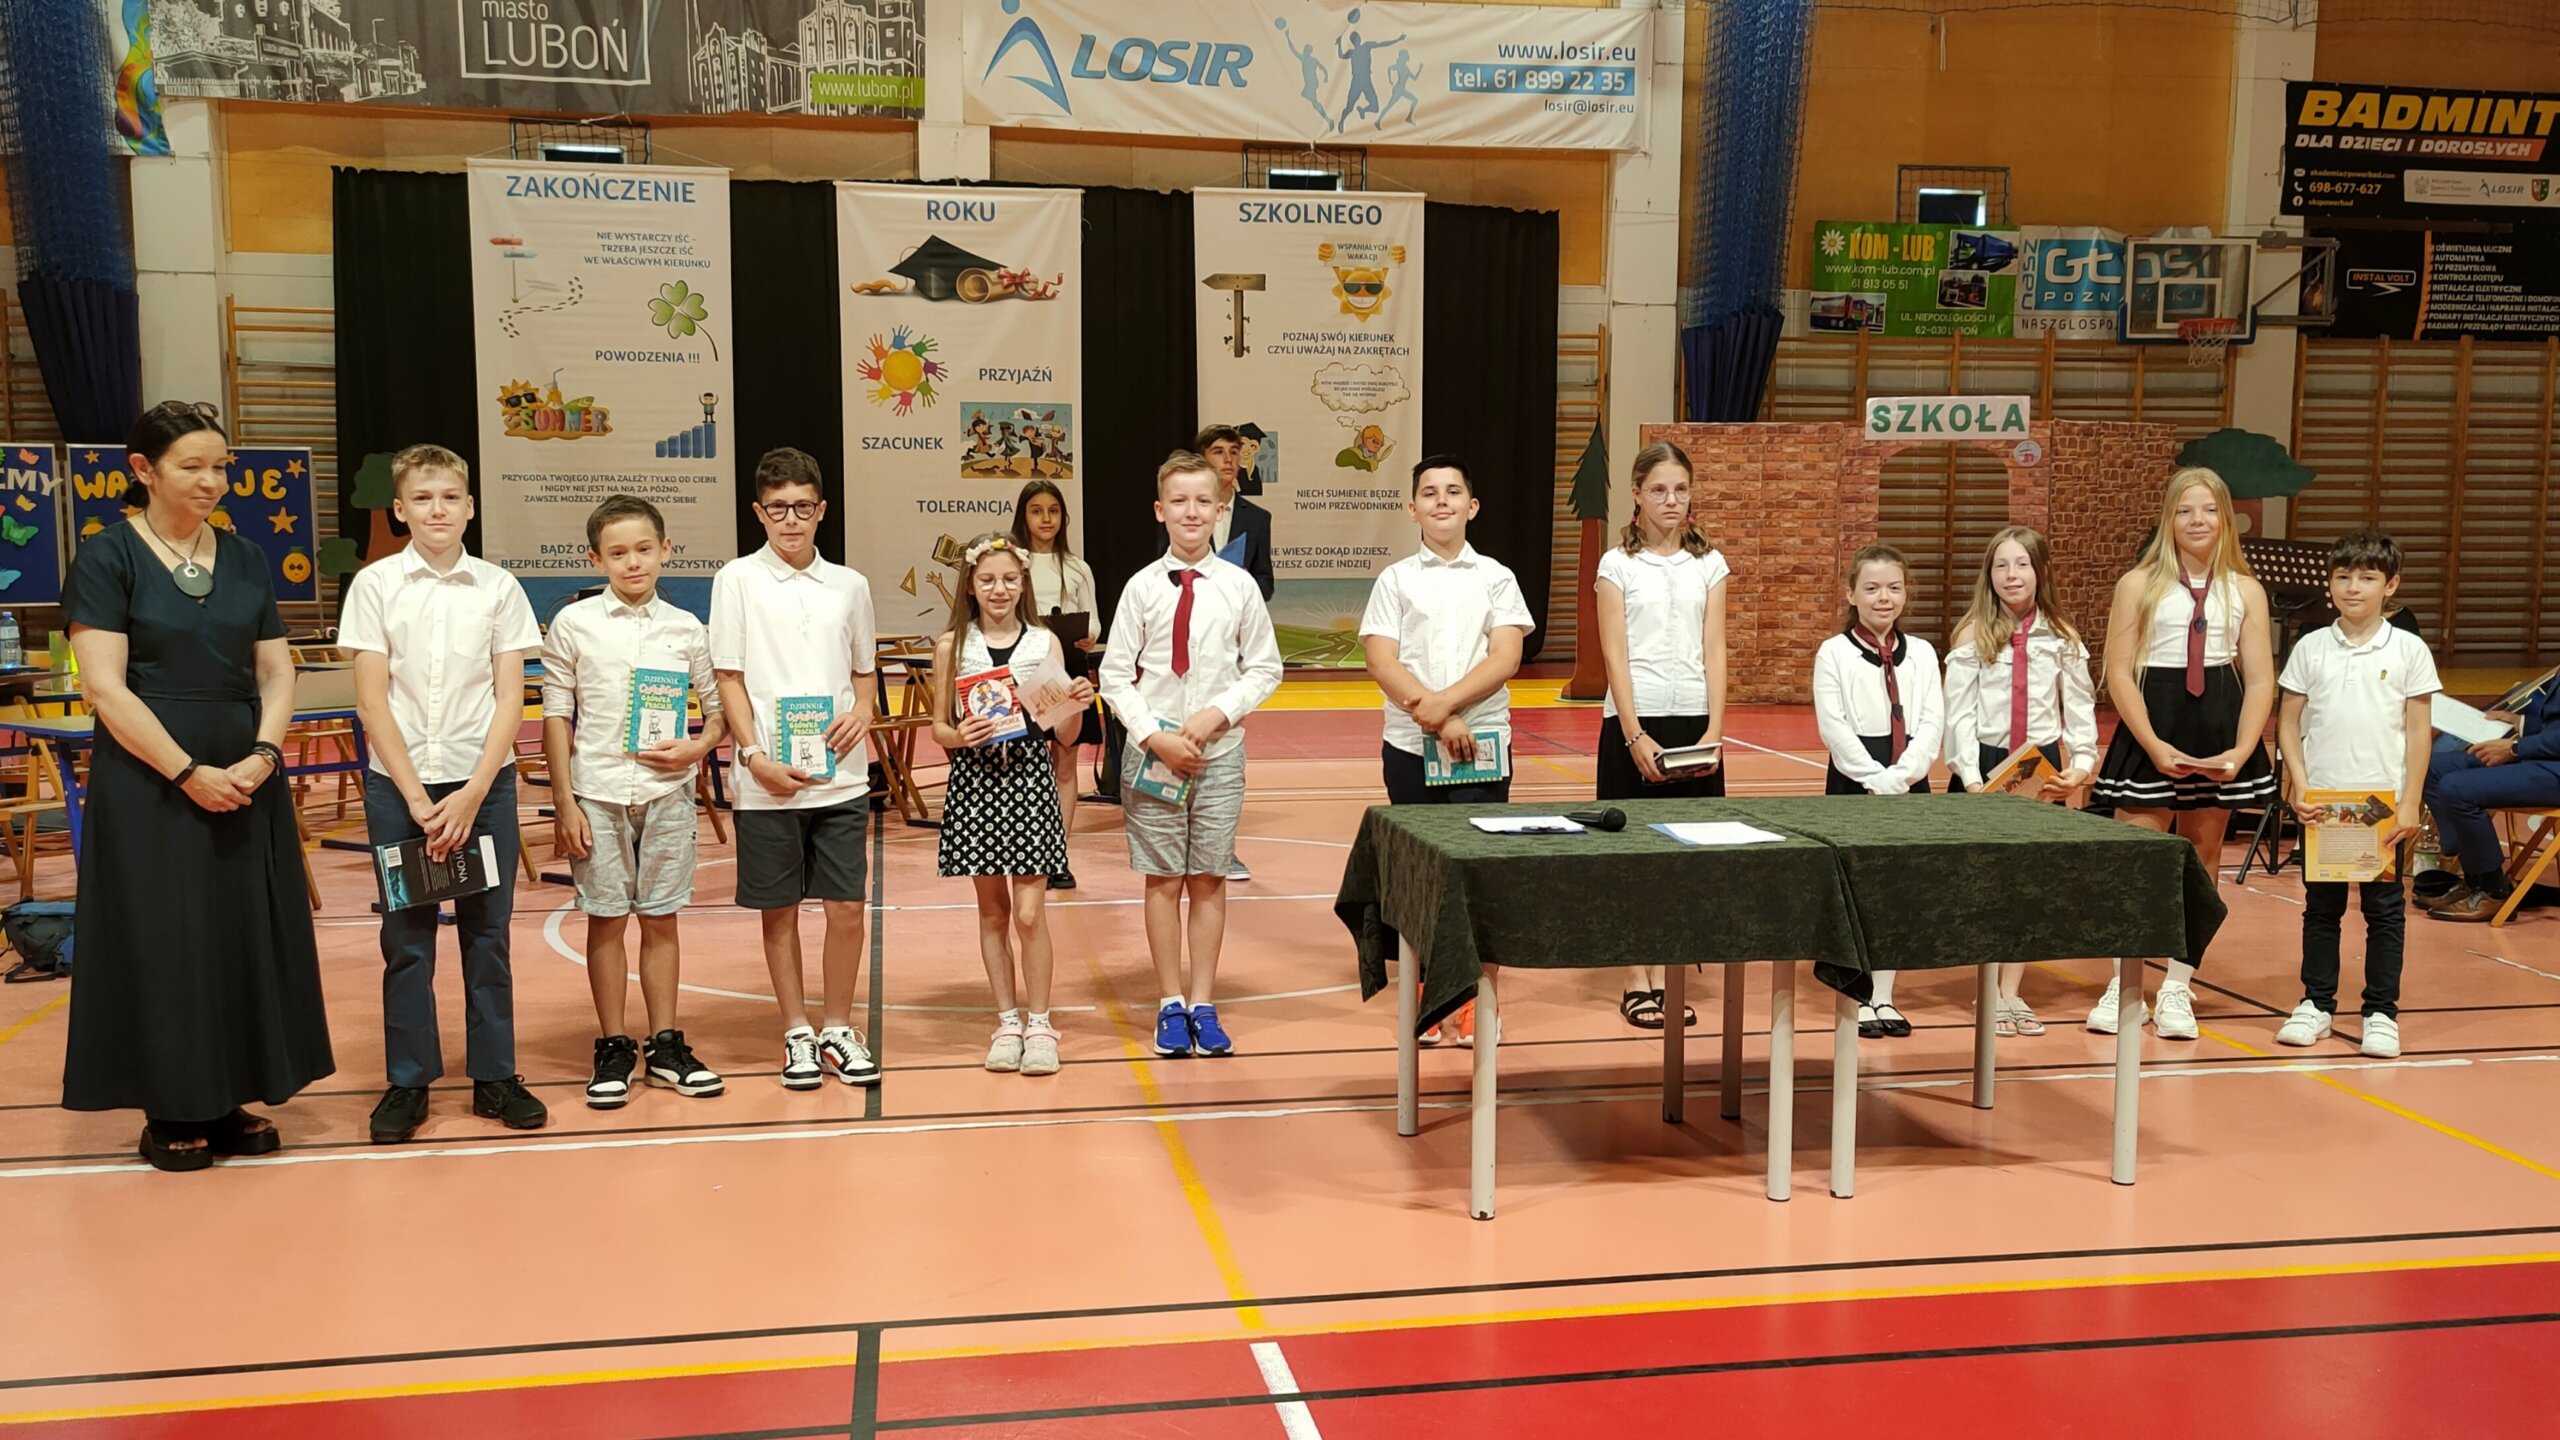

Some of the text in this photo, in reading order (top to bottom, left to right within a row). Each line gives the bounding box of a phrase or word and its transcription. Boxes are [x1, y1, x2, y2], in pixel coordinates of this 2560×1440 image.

[482, 0, 549, 21] miasto
[482, 18, 629, 73] LUBOŃ
[1498, 41, 1636, 62] www.losir.eu
[1071, 33, 1254, 88] LOSIR
[1454, 68, 1627, 92] tel. 61 899 22 35
[818, 80, 915, 100] www.lubon.pl
[1544, 99, 1635, 115] losir@losir.eu
[2297, 90, 2560, 137] BADMINT
[2295, 133, 2532, 157] DLA DZIECI I DOROSŁYCH
[505, 172, 697, 203] ZAKOŃCZENIE
[2309, 181, 2382, 195] 698-677-627
[2491, 184, 2524, 194] LOSIR
[926, 199, 996, 222] ROKU
[1238, 202, 1382, 226] SZKOLNEGO
[597, 231, 613, 241] NIE
[614, 232, 674, 243] WYSTARCZY
[675, 232, 690, 244] IŚĆ
[601, 244, 694, 256] TRZEBA JESZCZE IŚĆ
[1337, 243, 1388, 252] WSPANIAŁYCH
[1849, 231, 1890, 260] KOM
[2435, 243, 2513, 253] OŚWIETLENIA ULICZNE
[584, 255, 711, 269] WE WŁAŚCIWYM KIERUNKU
[2434, 254, 2486, 262] AUTOMATYKA
[1825, 263, 1936, 278] www.kom-lub.com.pl
[2445, 264, 2498, 272] PRZEMYSŁOWA
[2352, 272, 2410, 283] INSTAL VOLT
[2433, 273, 2504, 283] KONTROLA DOSTĘPU
[1851, 279, 1909, 290] 61 813 05 51
[2475, 285, 2523, 293] ELEKTRYCZNE
[2430, 303, 2486, 311] MODERNIZACJA
[1915, 311, 1987, 323] NIEPODLEGŁOŚCI
[2429, 312, 2462, 320] POMIARY
[1915, 325, 1978, 336] 62-030 LOŃ
[1282, 331, 1395, 343] POZNAJ SWÓJ KIERUNEK
[595, 350, 686, 364] POWODZENIA
[1267, 344, 1410, 358] CZYLI UWAŻAJ NA ZAKRĘTACH
[979, 365, 1052, 385] PRZYJAŹŃ
[520, 408, 609, 432] SUMMER
[1871, 403, 2026, 433] SZKOŁA
[861, 436, 944, 450] SZACUNEK
[502, 473, 718, 484] PRZYGODA TWOJEGO JUTRA ZALEŻY TYLKO OD CIEBIE
[545, 484, 571, 493] NIGDY
[588, 485, 606, 494] JEST
[607, 485, 620, 493] NA
[621, 485, 636, 495] NIĄ
[637, 485, 649, 493] ZA
[1296, 489, 1401, 500] NIECH SUMIENIE BĘDZIE
[524, 495, 559, 503] ZAWSZE
[560, 493, 594, 504] MOŻESZ
[673, 495, 698, 504] SIEBIE
[917, 500, 1013, 516] TOLERANCJA
[1294, 502, 1403, 511] TWOIM PRZEWODNIKIEM
[1282, 547, 1313, 556] WIESZ
[1315, 547, 1350, 557] DOKĄD
[661, 559, 725, 570] WSZYSTKO
[1305, 560, 1334, 569] GDZIE
[1336, 559, 1371, 570] INDZIEJ
